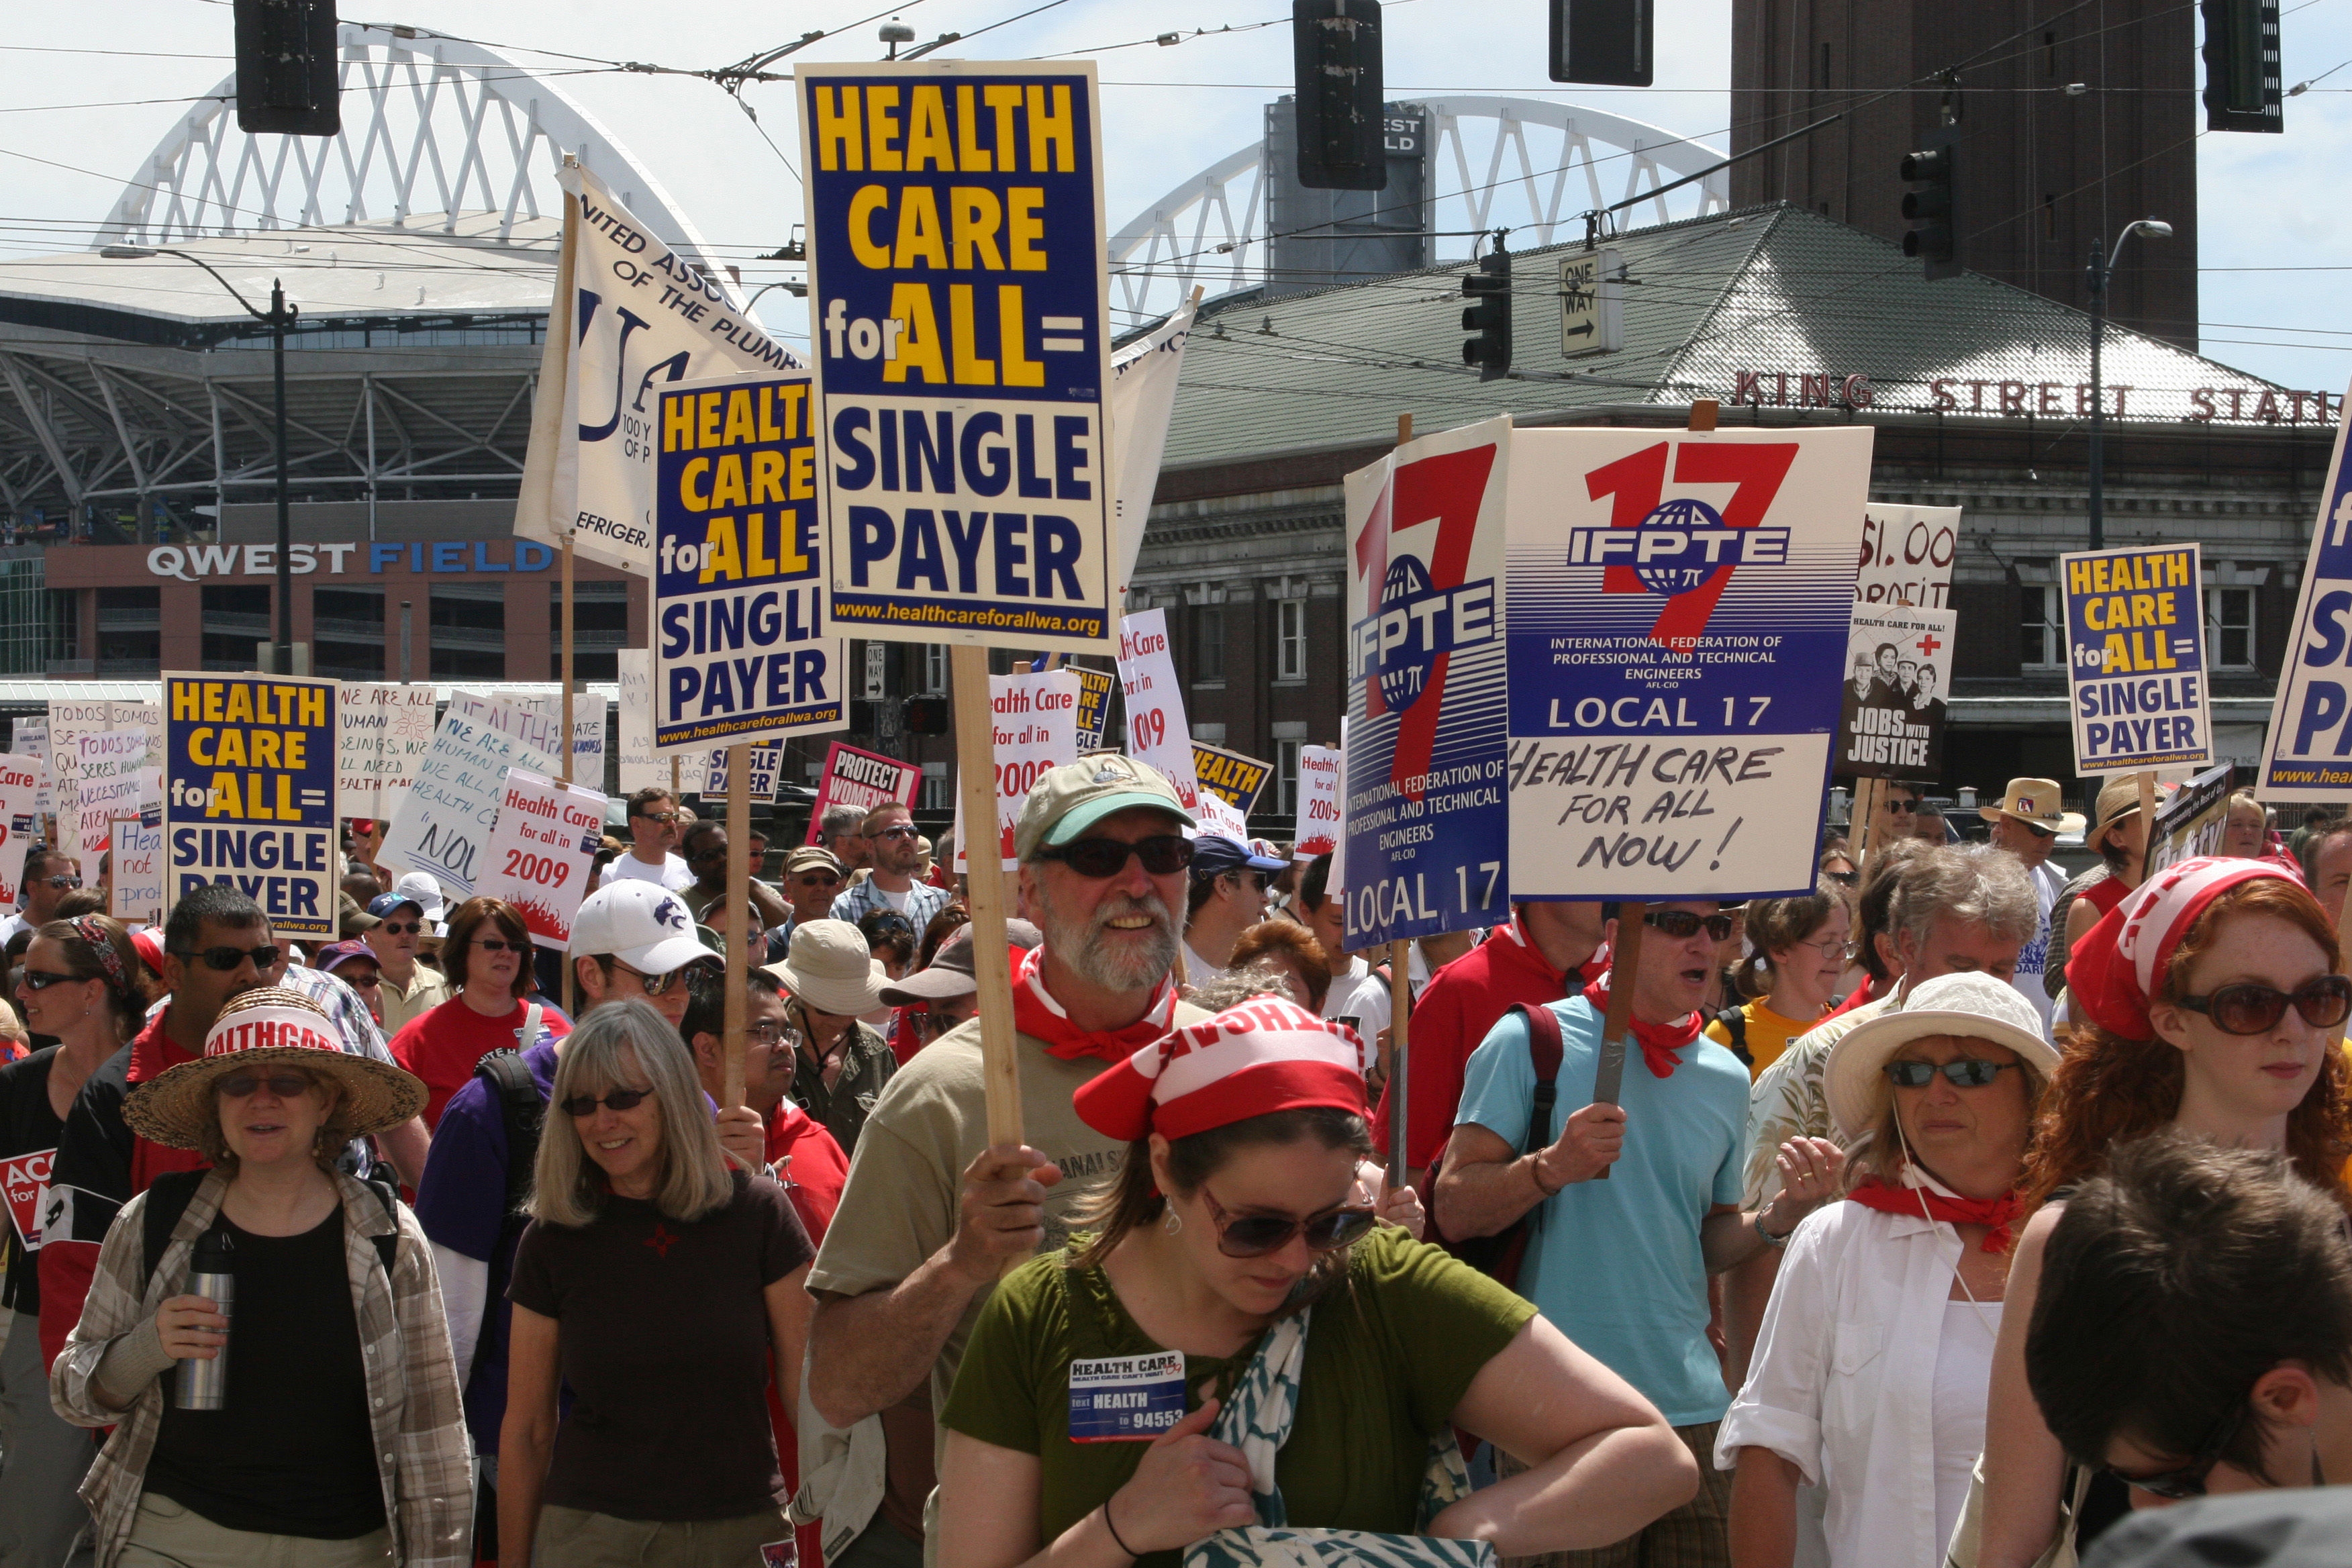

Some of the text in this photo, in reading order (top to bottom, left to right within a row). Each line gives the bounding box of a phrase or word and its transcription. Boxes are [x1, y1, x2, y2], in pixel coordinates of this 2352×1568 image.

[815, 85, 1075, 173] HEALTH
[579, 193, 646, 254] NITED
[848, 184, 1047, 271] CARE
[1565, 263, 1594, 289] ONE
[612, 260, 654, 290] OF
[658, 284, 710, 324] THE
[825, 298, 903, 361] for
[1735, 369, 2346, 424] KING STREET STATI
[623, 414, 640, 438] 100
[624, 438, 640, 459] OF
[833, 406, 1092, 501] SINGLE
[680, 446, 815, 513] CARE
[576, 511, 651, 549] EFRIGER
[147, 541, 554, 582] QWEST FIELD
[660, 534, 716, 575] for
[848, 505, 1085, 601] PAYER
[1569, 530, 1787, 564] IFPTE
[2069, 552, 2189, 595] HEALTH
[834, 602, 1101, 637] www.healthcareforallwa.org
[1853, 617, 1946, 632] HEALTH CARE FOR ALL!
[2084, 592, 2177, 631] CARE
[1132, 631, 1165, 656] Care
[1351, 584, 1494, 677] IFPTE
[1551, 636, 1783, 649] INTERNATIONAL FEDERATION OF
[868, 648, 883, 662] ONE
[1553, 652, 1776, 665] PROFESSIONAL AND TECHNICAL
[2074, 643, 2111, 668] for
[669, 648, 827, 722] PAYER
[868, 665, 883, 678] WAY
[1625, 668, 1702, 679] ENGINEERS
[172, 681, 326, 728] HEALTH
[371, 689, 402, 706] ARE
[407, 691, 435, 706] ALL
[1035, 687, 1073, 712] Care
[1079, 690, 1101, 709] RE
[1124, 682, 1134, 696] or
[2078, 676, 2199, 719] SINGLE
[52, 706, 159, 725] TODOS SOMOS
[341, 713, 388, 729] UMAN
[658, 707, 838, 745] www.healthcareforallwa.org
[1549, 696, 1771, 728] LOCAL 17
[1850, 707, 1930, 738] JOBS WITH
[79, 734, 123, 758] TODOS
[188, 727, 307, 771] CARE
[341, 736, 429, 755] EINGS, WE
[446, 718, 473, 743] WE
[476, 732, 510, 758] ARE
[518, 752, 547, 773] ALL
[993, 724, 1049, 745] for all in
[1076, 732, 1098, 750] GLE
[2086, 715, 2197, 756] PAYER
[341, 757, 403, 773] LL NEED
[433, 738, 493, 771] HUMAN
[709, 749, 778, 771] SILE
[1302, 756, 1333, 773] Health
[1508, 740, 1785, 791] HEALTH CARE
[1847, 734, 1929, 767] JUSTICE
[2082, 752, 2205, 770] www.healthcareforallwa.org
[80, 761, 117, 781] SERES
[340, 777, 382, 791] EALTH
[422, 758, 449, 781] WE
[455, 771, 484, 794] ALL
[709, 772, 771, 792] PER
[833, 750, 901, 792] PROTECT
[1314, 778, 1324, 789] for
[1348, 759, 1504, 813] INTERNATIONAL FEDERATION OF
[171, 778, 220, 807] for
[411, 780, 475, 814] HEALTH
[1558, 788, 1715, 826] FOR ALL
[505, 788, 558, 820] Health
[562, 805, 599, 830] Care
[1220, 808, 1244, 836] Care
[1348, 787, 1502, 838] PROFESSIONAL AND TECHNICAL
[121, 824, 162, 851] Hea
[173, 828, 326, 873] SINGLE
[520, 822, 537, 840] for
[540, 825, 556, 844] all
[559, 830, 571, 849] in
[1379, 823, 1434, 851] ENGINEERS
[123, 852, 153, 875] not
[501, 848, 570, 889] 2009
[1391, 848, 1416, 863] AFL-CIO
[180, 873, 320, 917] PYER
[1347, 861, 1500, 936] LOCAL 17
[204, 1021, 341, 1058] EALTHCAR
[11, 1188, 35, 1203] for
[1072, 1355, 1176, 1376] HEALTH CARE
[1071, 1392, 1148, 1409] text HEALTH
[1119, 1410, 1183, 1428] to 94553
